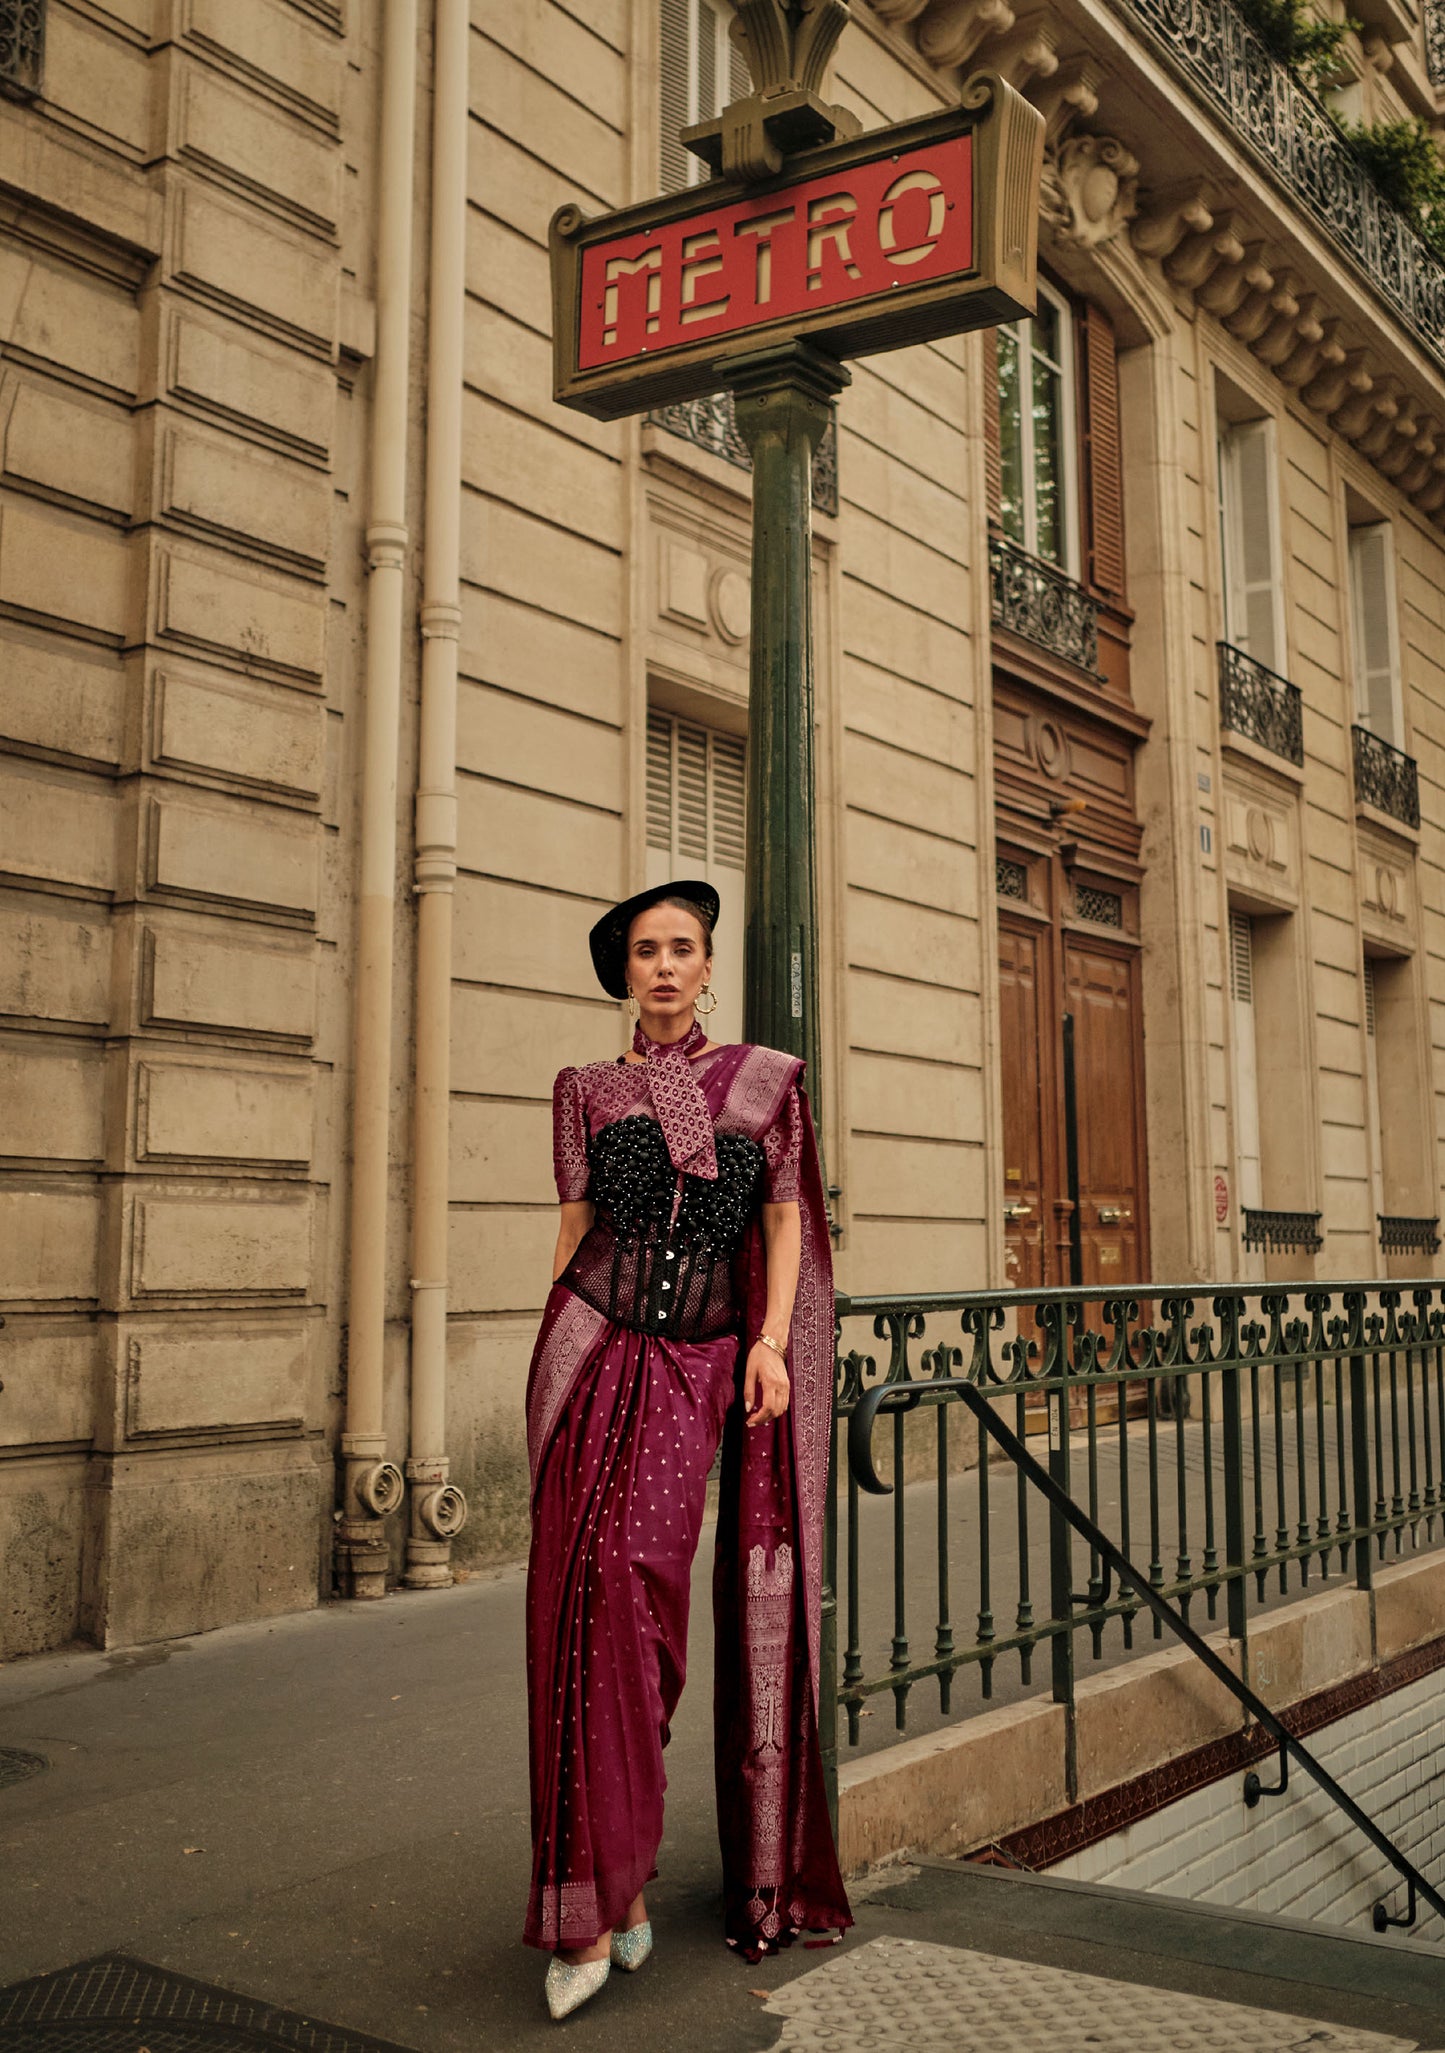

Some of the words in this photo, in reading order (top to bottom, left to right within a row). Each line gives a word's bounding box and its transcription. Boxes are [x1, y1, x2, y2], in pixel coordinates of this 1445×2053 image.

[602, 169, 946, 346] METRO
[792, 962, 801, 979] CA
[792, 985, 801, 1007] 204
